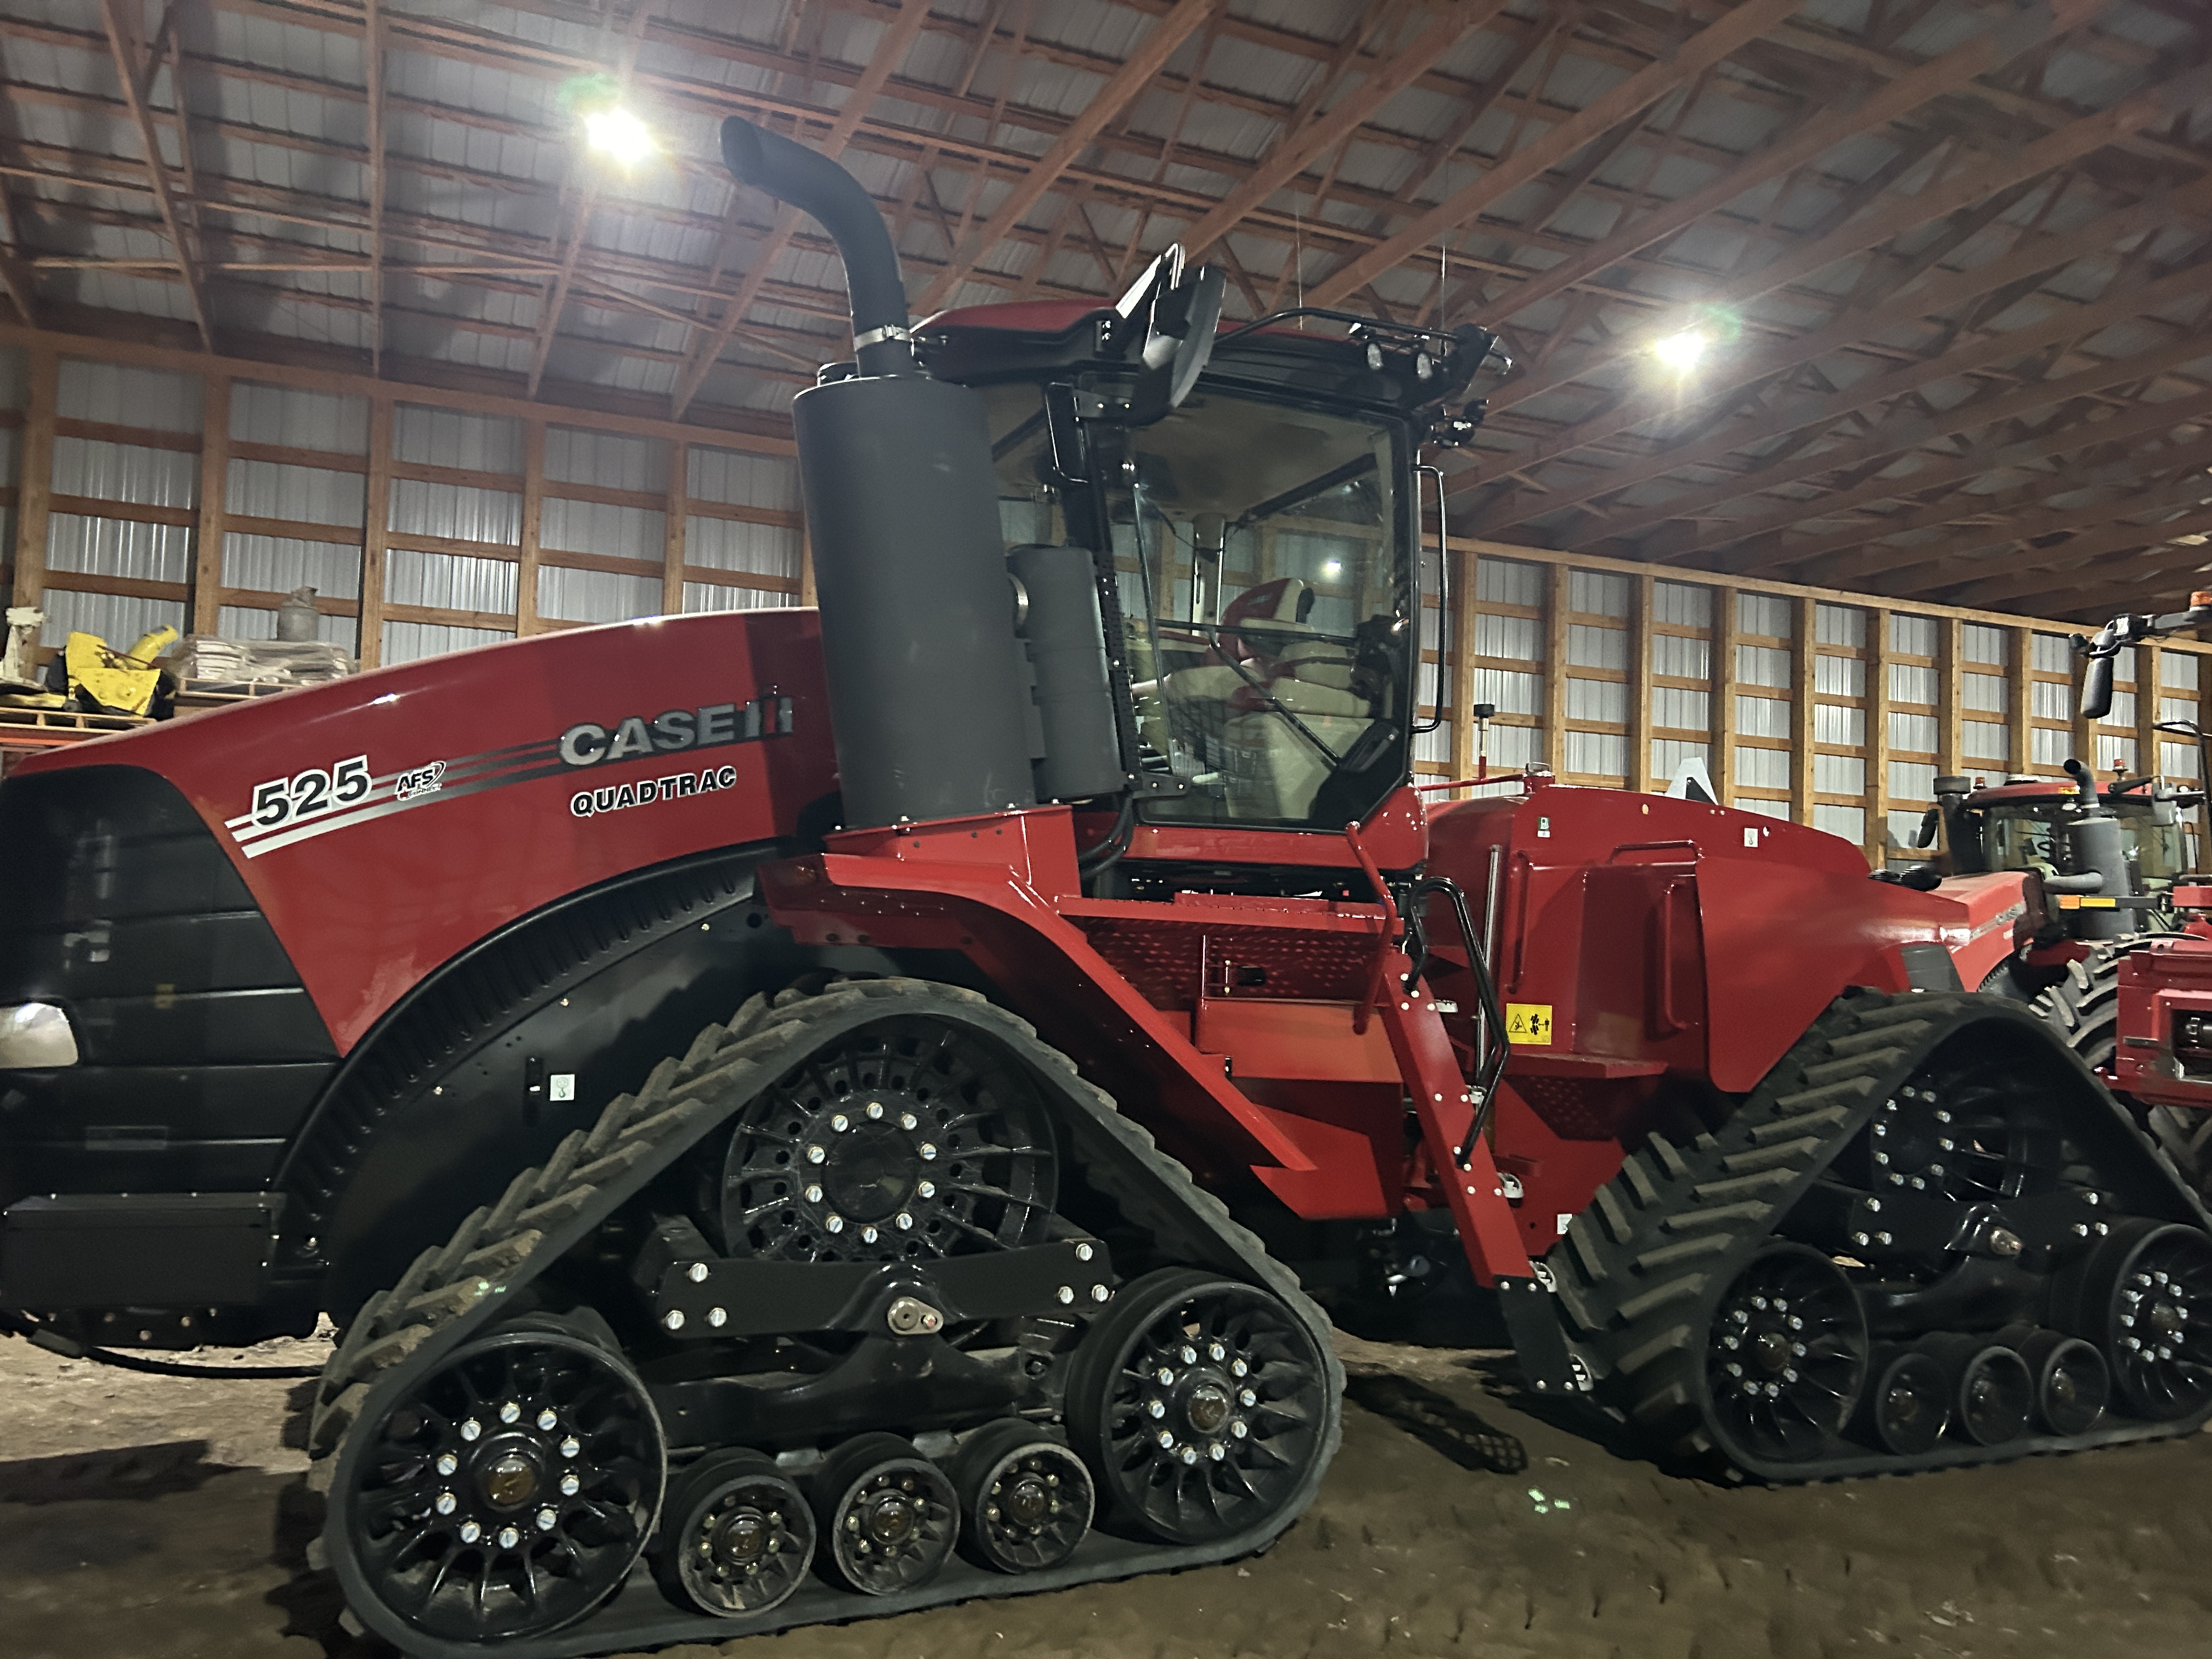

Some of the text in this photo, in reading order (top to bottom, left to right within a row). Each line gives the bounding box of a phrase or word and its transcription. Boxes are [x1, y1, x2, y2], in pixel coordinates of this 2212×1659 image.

[559, 703, 735, 766] CASE
[252, 755, 373, 829] 525
[396, 768, 435, 793] AFS
[571, 765, 737, 817] QUADTRAC
